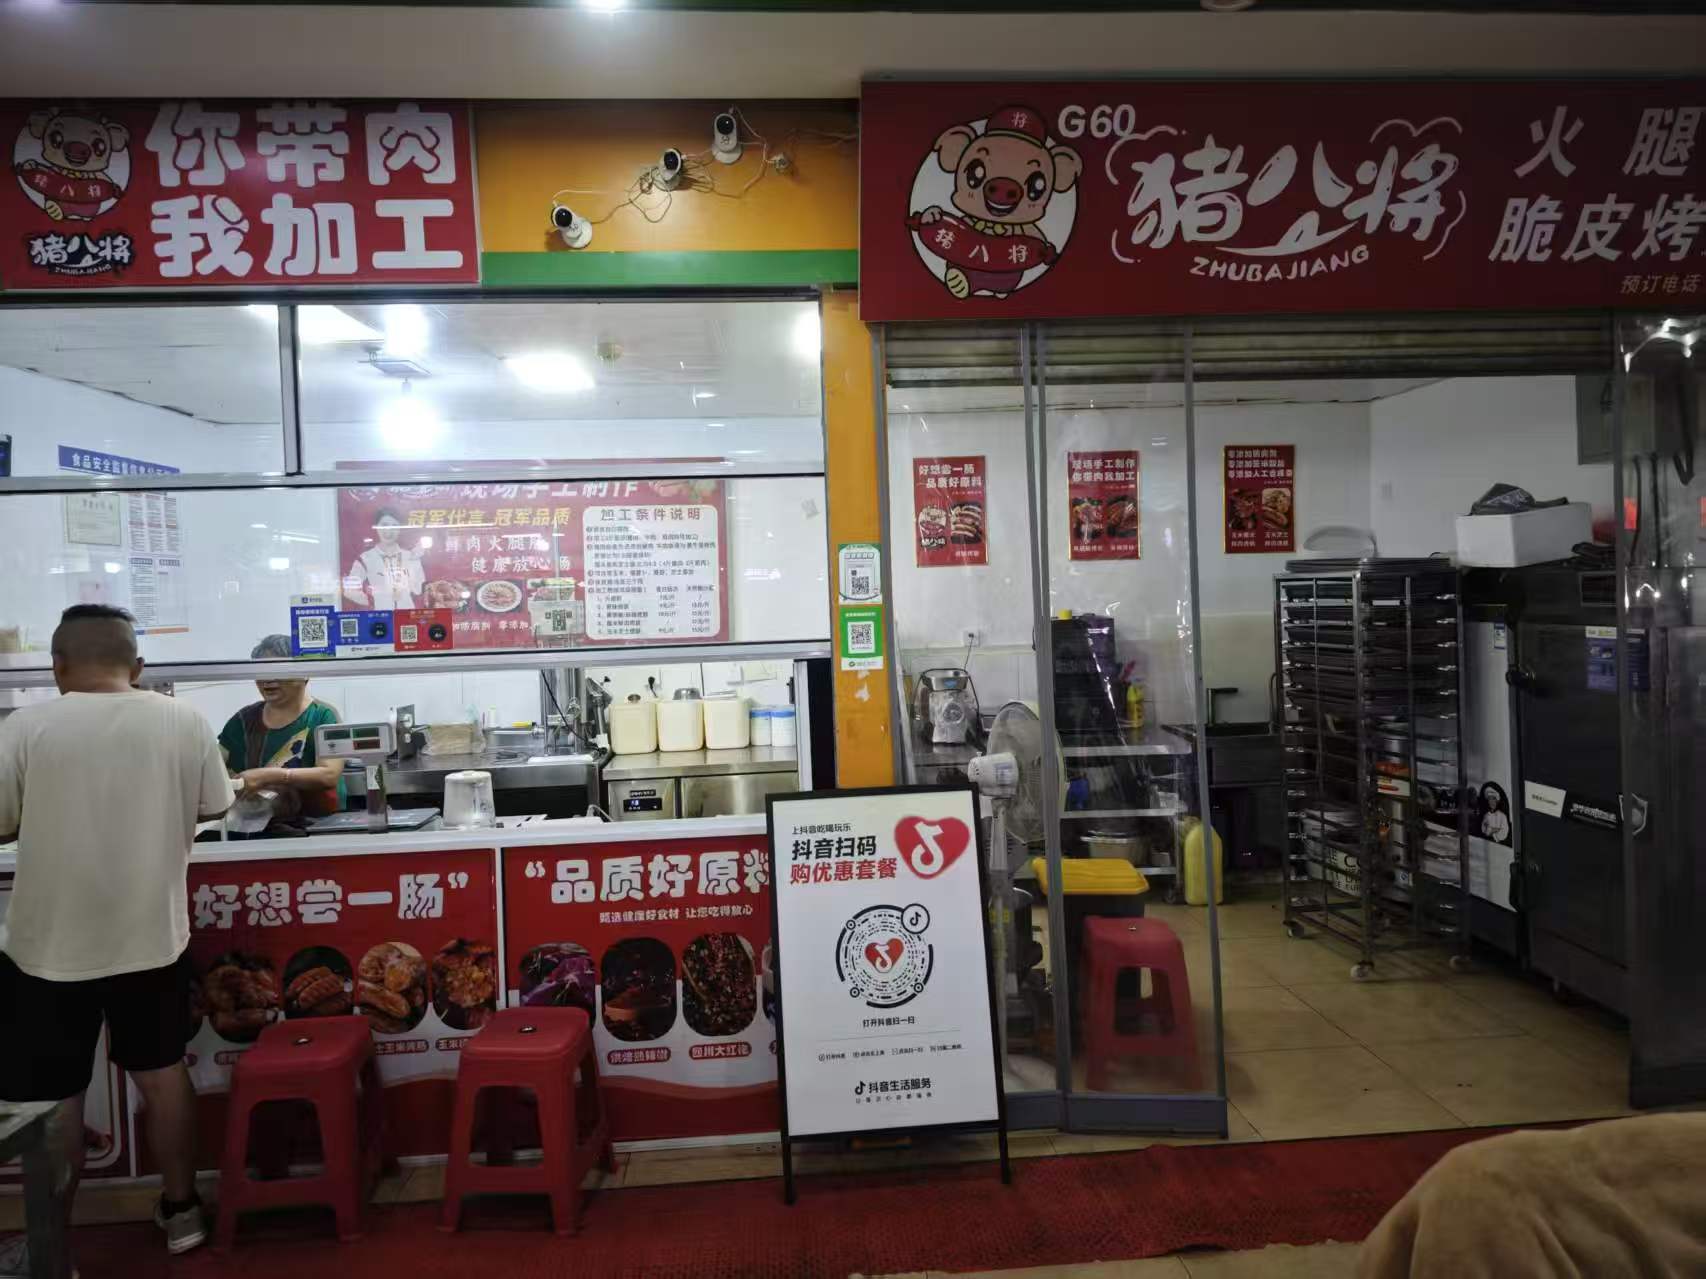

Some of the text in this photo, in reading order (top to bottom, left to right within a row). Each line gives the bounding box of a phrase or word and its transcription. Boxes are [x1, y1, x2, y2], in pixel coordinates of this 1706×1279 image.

[1058, 103, 1137, 138] G60
[145, 102, 458, 187] 你带肉
[1127, 133, 1460, 257] 猪八将
[151, 193, 464, 278] 我加工
[1489, 192, 1706, 264] 脆皮烤
[29, 233, 131, 265] 猪八将
[934, 228, 1029, 264] 猪八将
[1190, 244, 1370, 283] ZHUBAJIANG
[1620, 274, 1702, 295] 预订电话
[926, 477, 982, 489] 品质好原料
[1072, 471, 1136, 482] 你带肉我加工
[407, 506, 572, 528] 冠军代言 冠军品质
[600, 507, 700, 522] 加工条件说明
[792, 823, 851, 835] 上抖音吃喝玩乐
[791, 835, 876, 861] 抖音扫码
[790, 857, 897, 885] 购优惠套餐
[863, 1016, 915, 1028] 打开抖音扫一扫
[868, 1077, 932, 1094] 抖音生活服务
